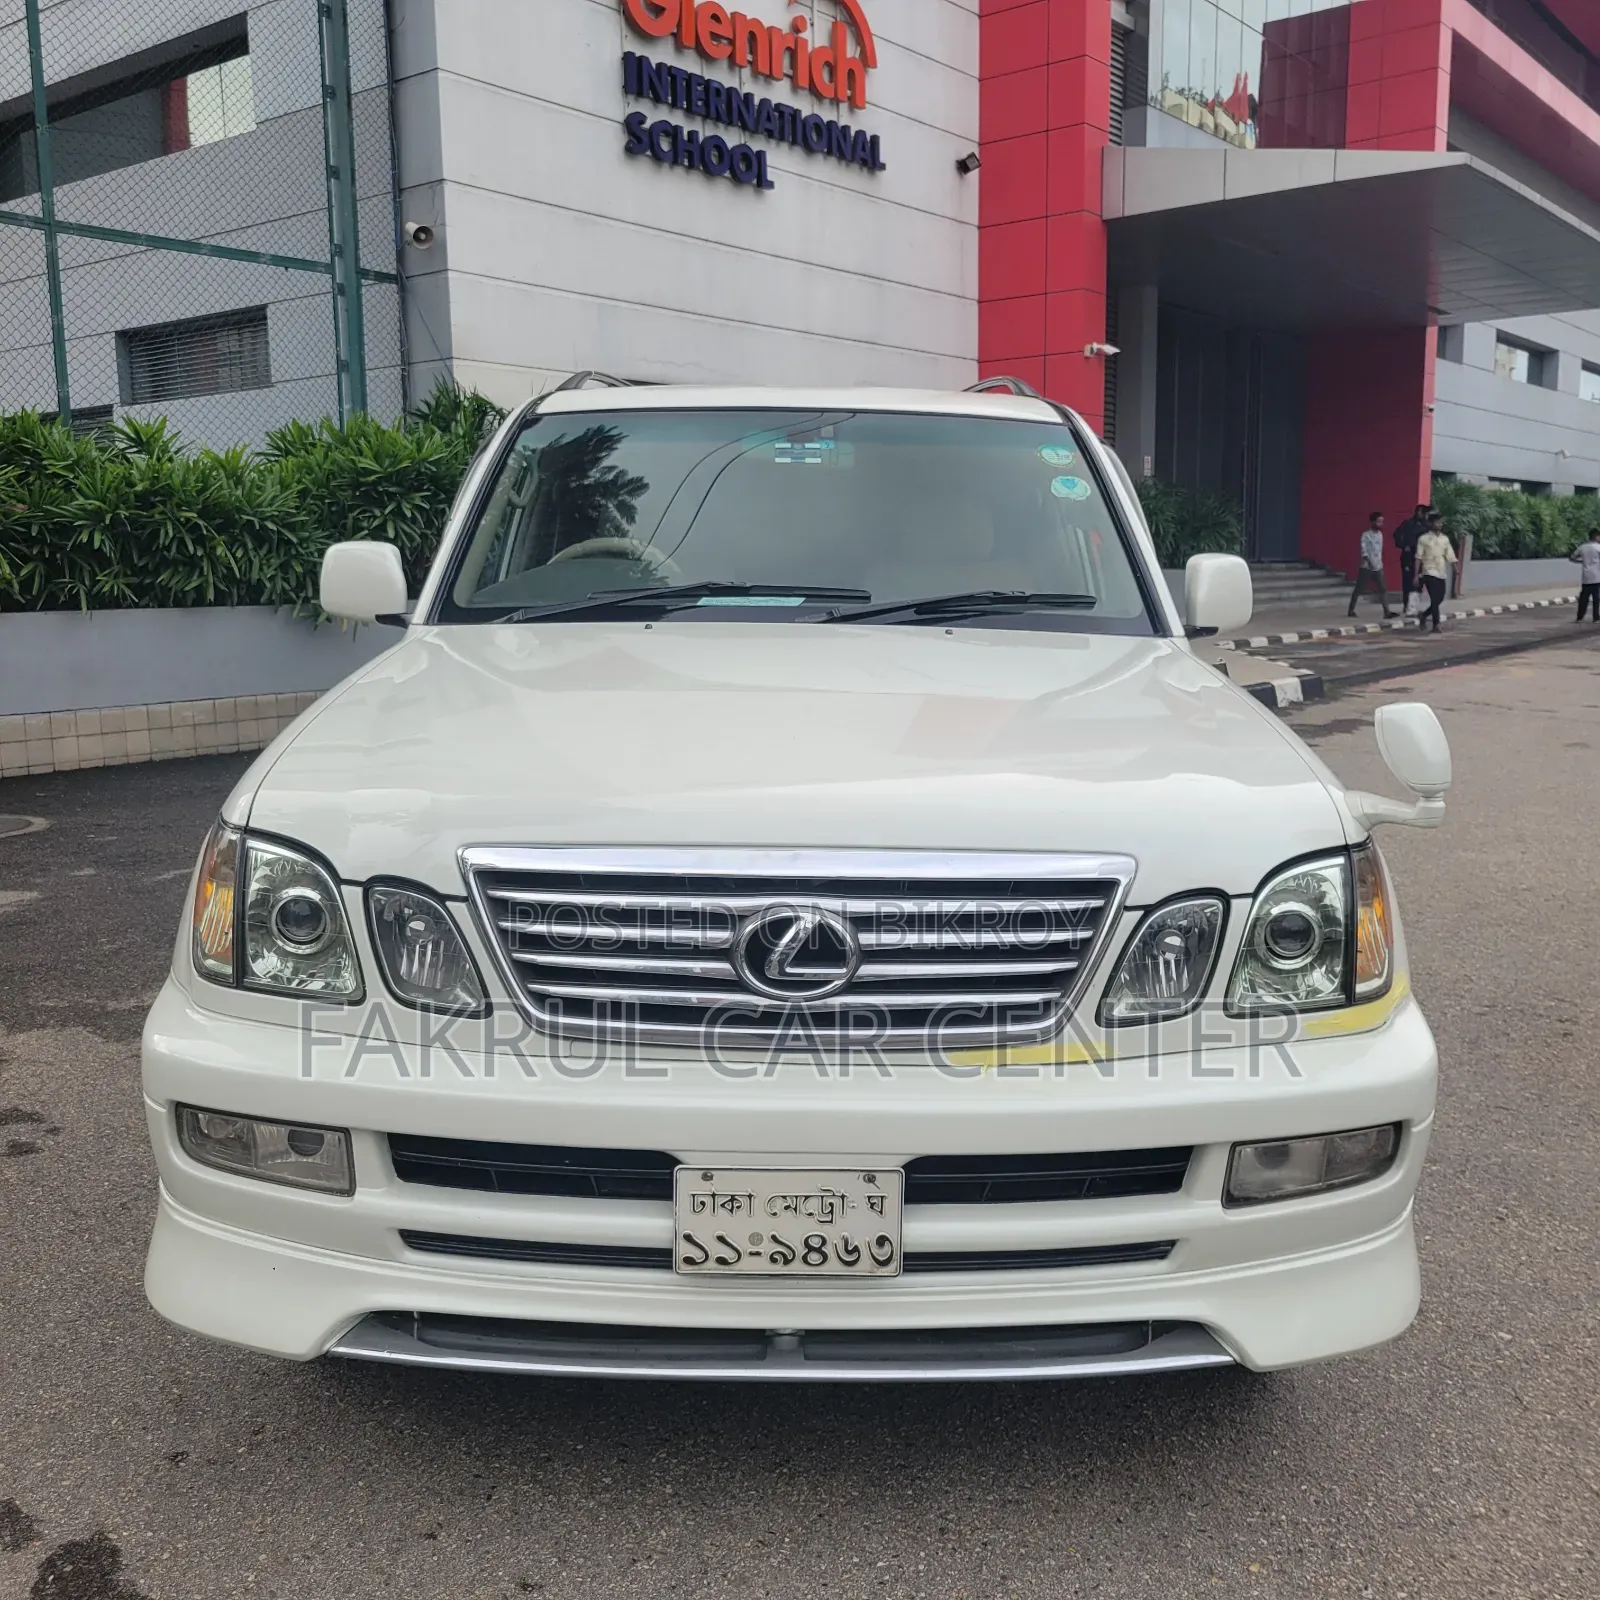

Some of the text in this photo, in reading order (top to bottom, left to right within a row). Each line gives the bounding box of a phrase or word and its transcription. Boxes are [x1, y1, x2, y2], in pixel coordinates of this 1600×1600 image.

[622, 51, 886, 171] INTERNATIONAL
[624, 111, 775, 189] SCHOOL
[689, 1189, 755, 1217] ঢাকা
